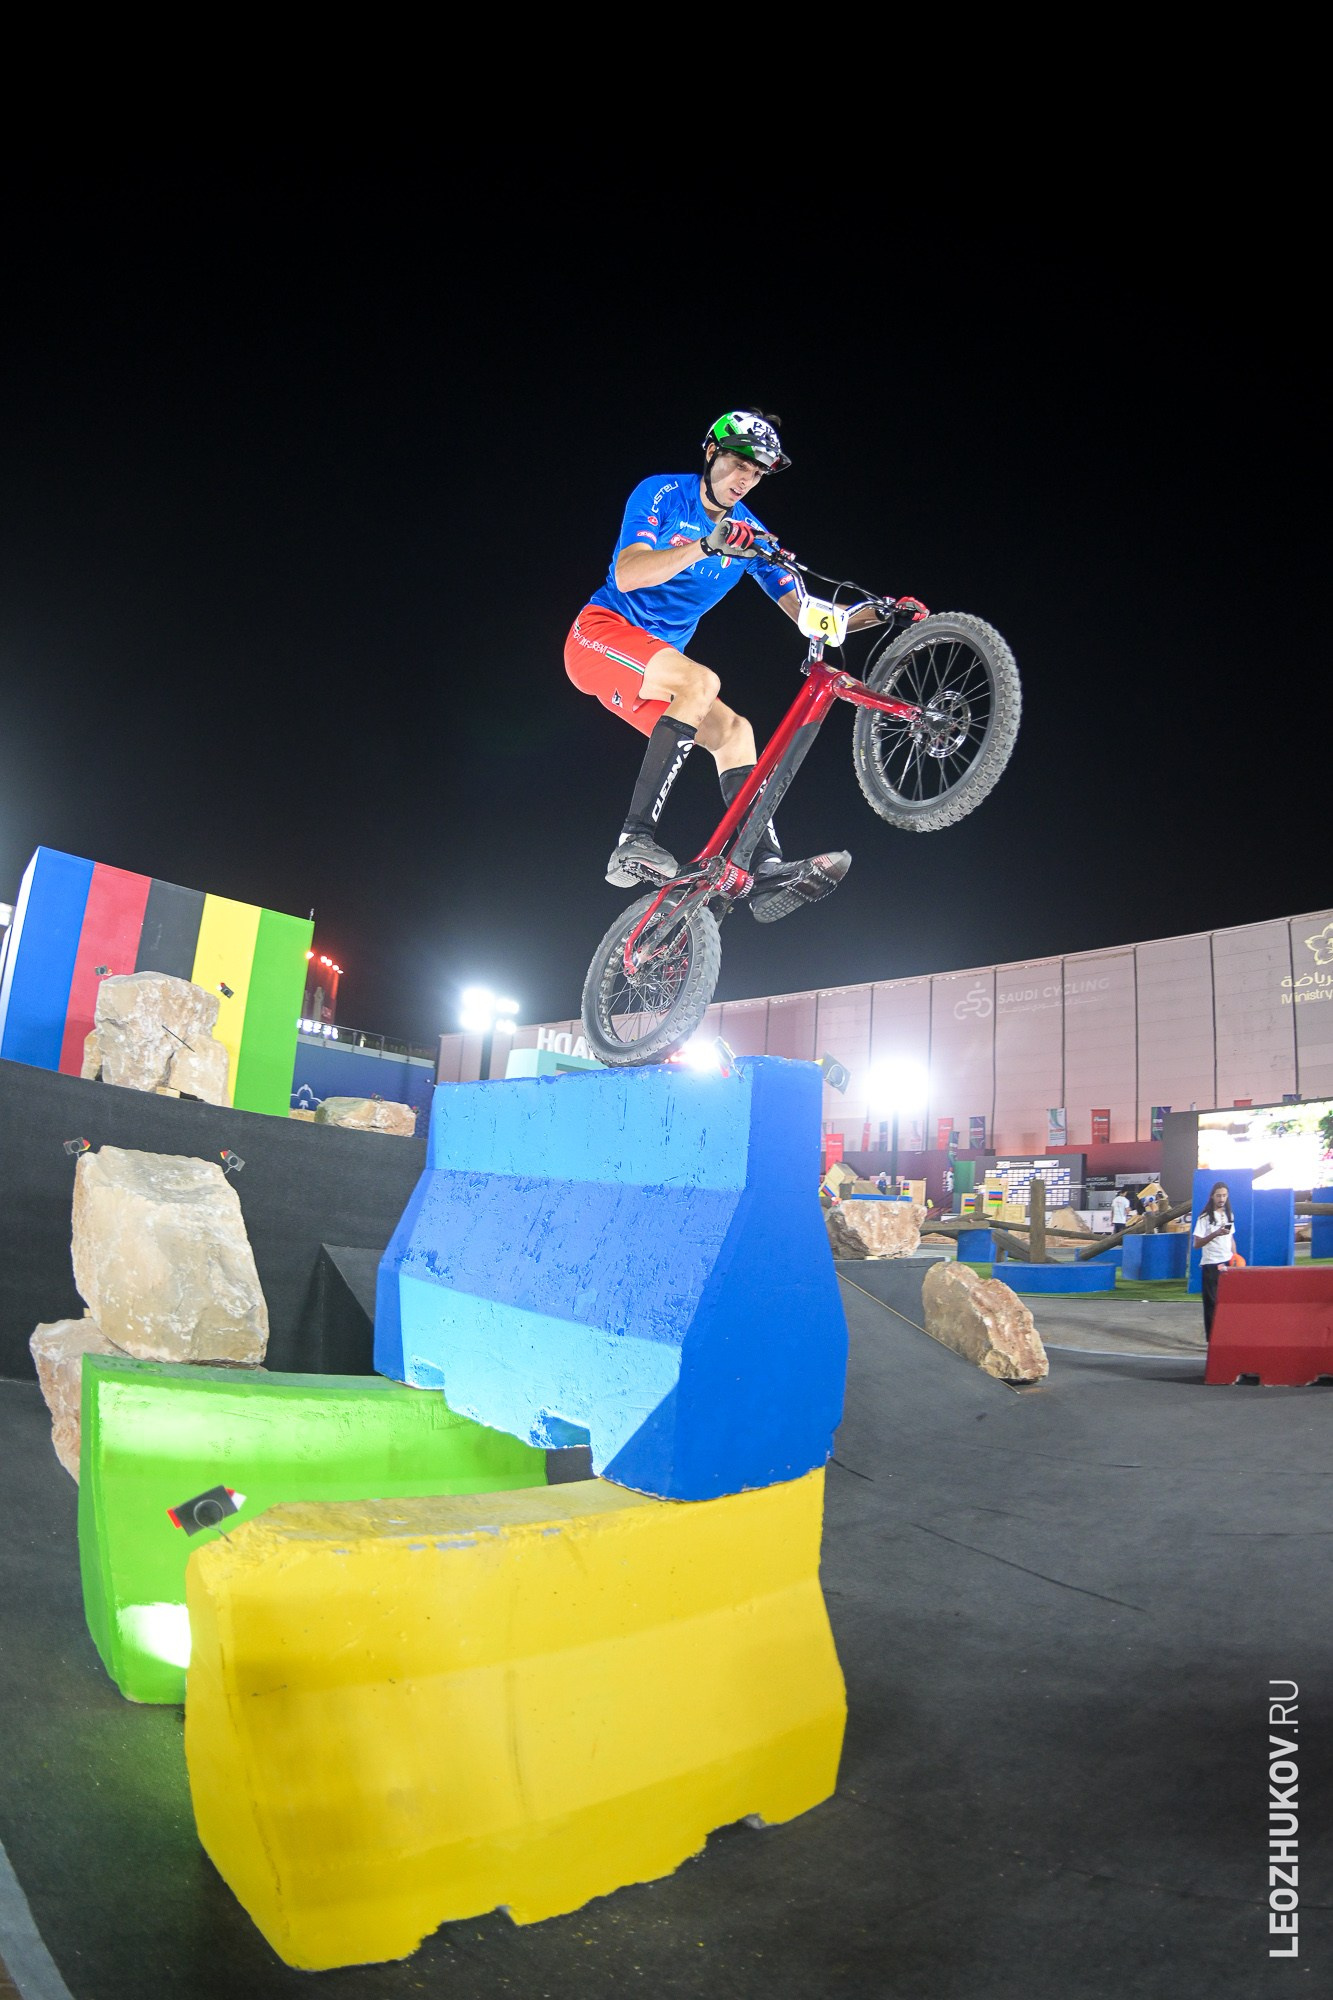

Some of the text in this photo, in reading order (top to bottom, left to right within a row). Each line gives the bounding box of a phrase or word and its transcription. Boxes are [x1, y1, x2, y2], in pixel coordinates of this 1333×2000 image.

[820, 616, 829, 630] 6
[998, 989, 1038, 1005] SAUDI
[1042, 977, 1110, 999] CYCLING
[1281, 988, 1333, 1005] Ministry
